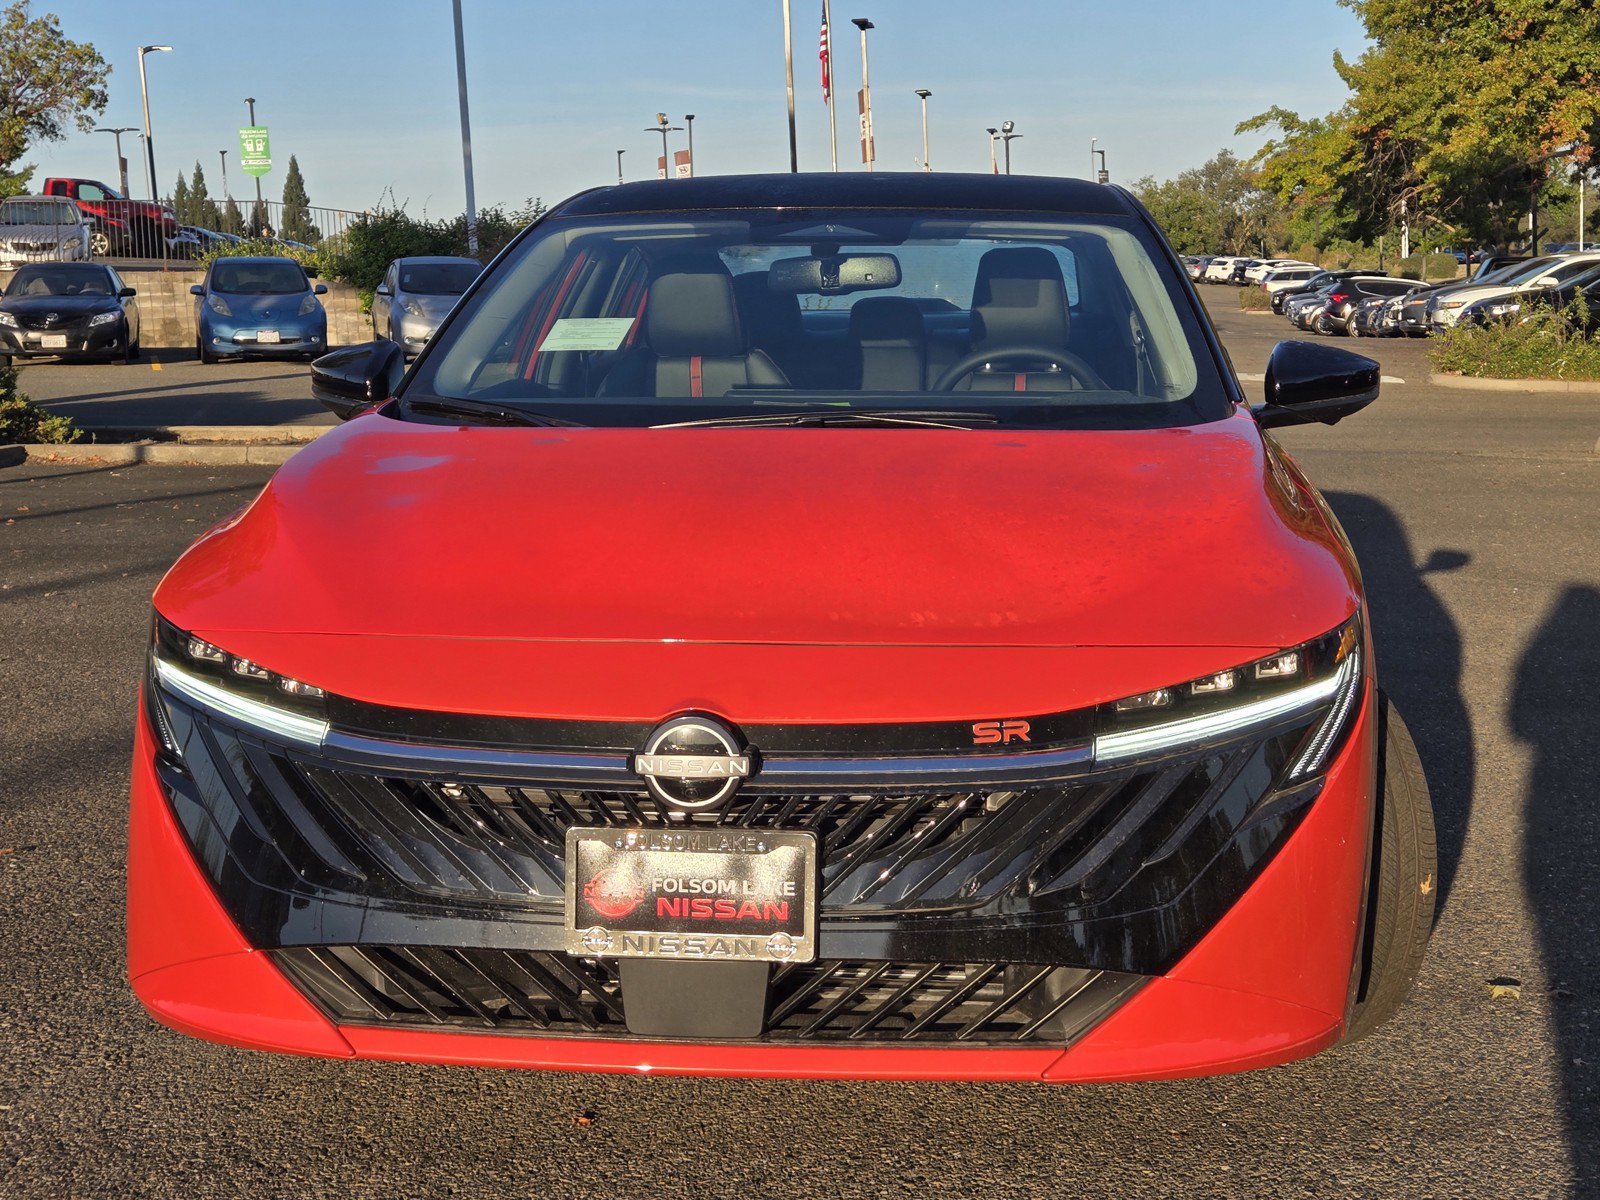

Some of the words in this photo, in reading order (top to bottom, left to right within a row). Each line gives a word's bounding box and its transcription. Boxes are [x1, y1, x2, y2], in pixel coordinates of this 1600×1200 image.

[972, 720, 1031, 743] SR
[637, 758, 747, 774] NISSAN
[626, 833, 701, 851] FOLSOM
[706, 835, 757, 852] LAKE
[652, 877, 737, 895] FOLSOM
[656, 896, 789, 922] NISSAN
[621, 934, 757, 957] NISSAN
